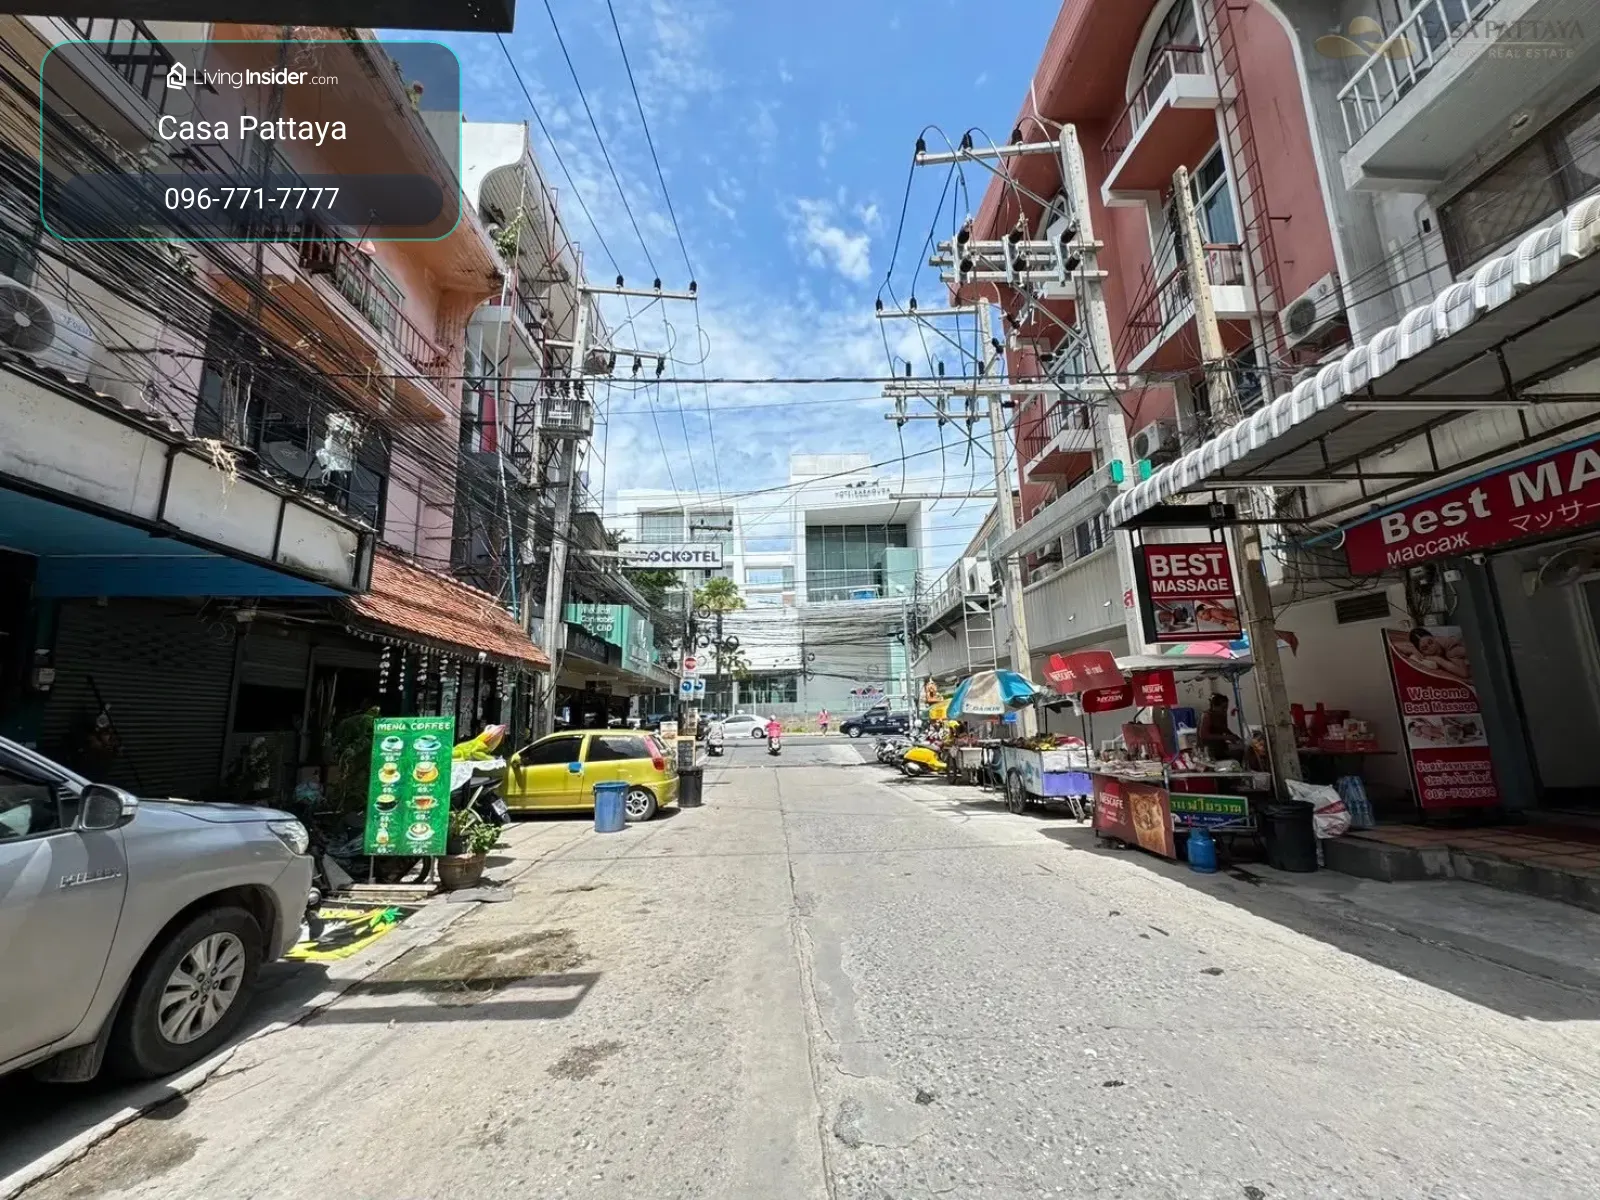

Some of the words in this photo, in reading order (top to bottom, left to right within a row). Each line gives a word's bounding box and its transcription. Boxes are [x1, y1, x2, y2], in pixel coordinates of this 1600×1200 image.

[1380, 487, 1492, 545] Best
[1387, 531, 1471, 565] массаж
[1149, 553, 1223, 577] BEST
[1152, 578, 1230, 593] MASSAGE
[1406, 686, 1470, 700] Welcome
[1405, 702, 1430, 713] Best
[1432, 701, 1478, 713] Massage
[377, 722, 406, 731] MENU
[411, 722, 452, 730] COFFEE
